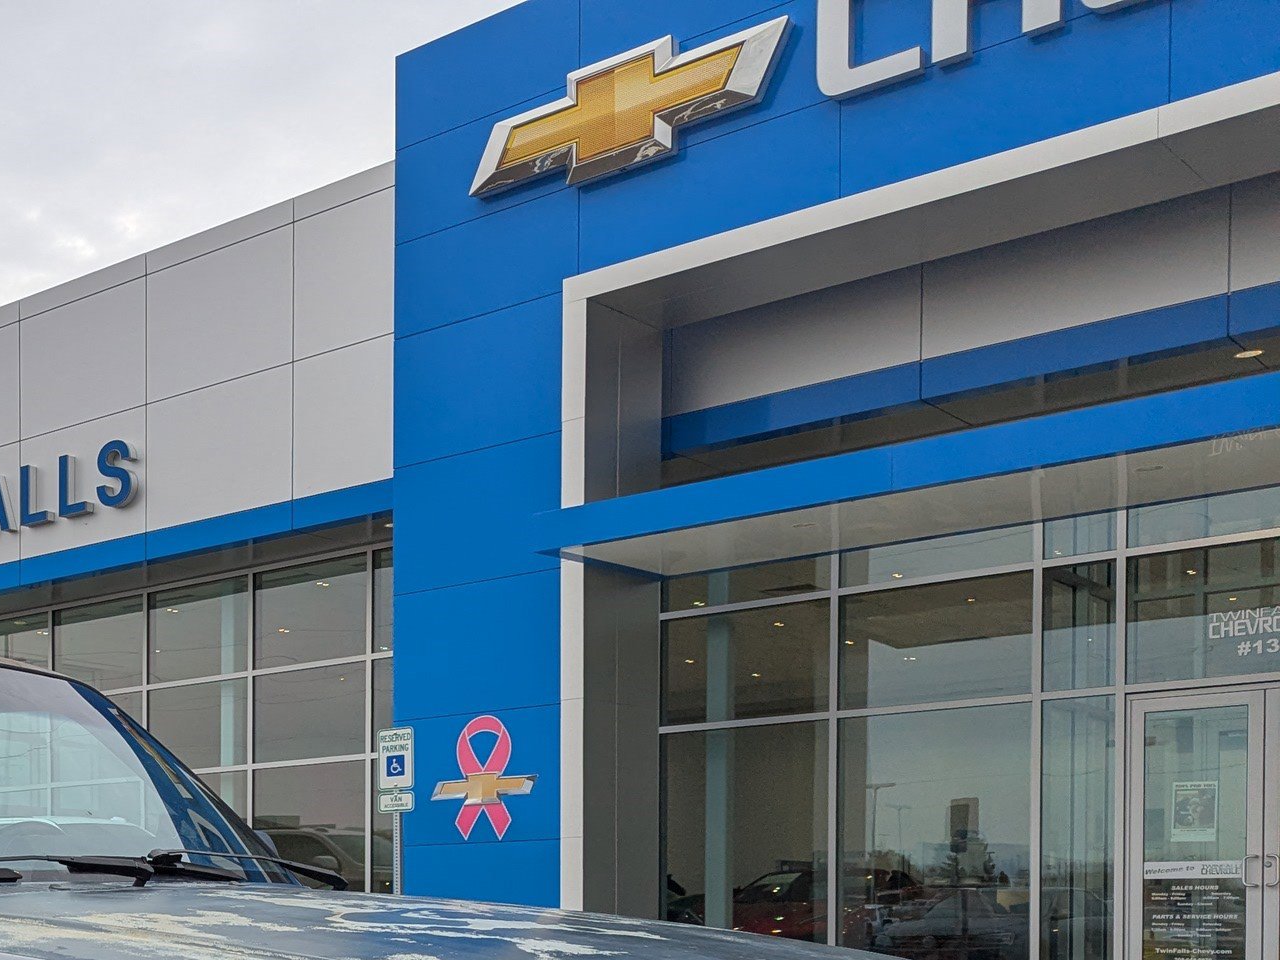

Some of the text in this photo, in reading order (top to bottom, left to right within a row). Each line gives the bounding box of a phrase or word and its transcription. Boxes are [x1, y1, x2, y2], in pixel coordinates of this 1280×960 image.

[380, 732, 411, 743] RESERVED
[381, 743, 409, 753] PARKING
[1145, 866, 1184, 875] Welcome
[1155, 947, 1233, 955] TwinFalls-Chevy.com
